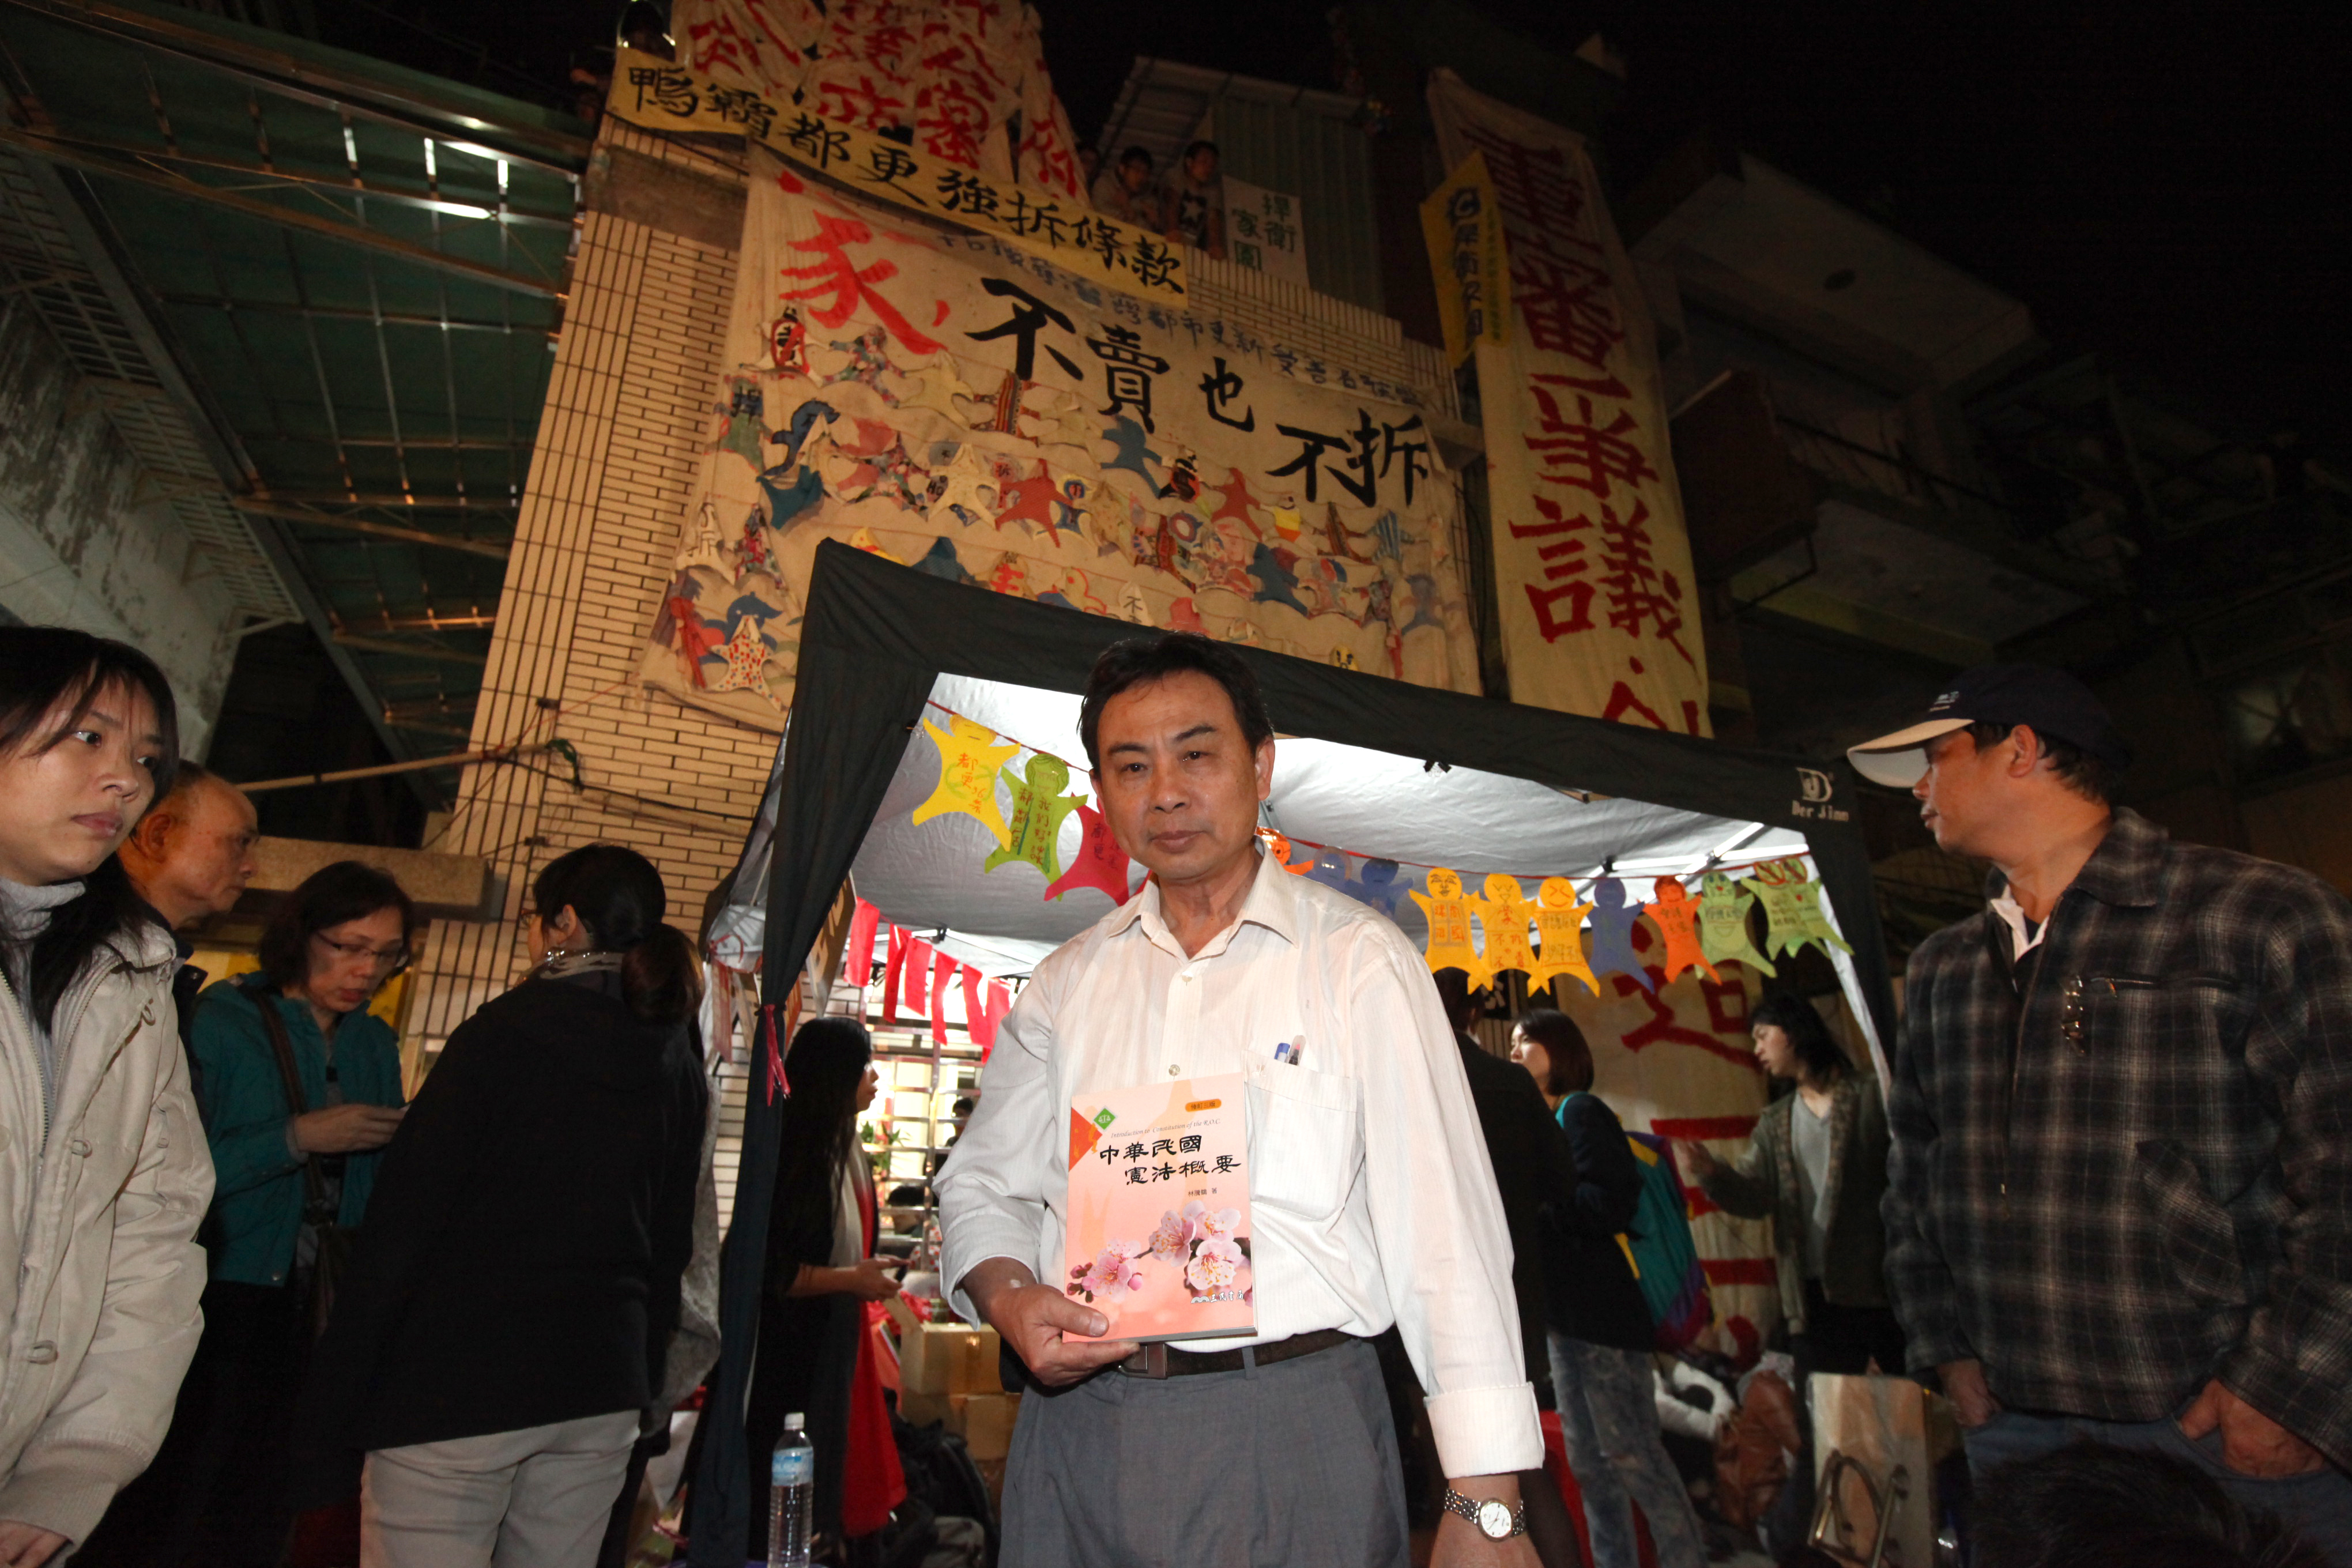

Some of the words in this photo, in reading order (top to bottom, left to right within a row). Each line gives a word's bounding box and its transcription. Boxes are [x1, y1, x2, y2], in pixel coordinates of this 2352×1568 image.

[630, 66, 1183, 295] 鴨霸都更強拆條款
[1190, 1100, 1216, 1111] 修訂三版
[1111, 1128, 1143, 1139] Introduction
[1152, 1123, 1186, 1133] Constitution
[1186, 1121, 1193, 1130] of
[1203, 1118, 1222, 1127] R.O.C.
[1100, 1134, 1202, 1165] 中華民國
[1125, 1155, 1242, 1185] 憲法概要
[1210, 1289, 1244, 1303] 三民書局
